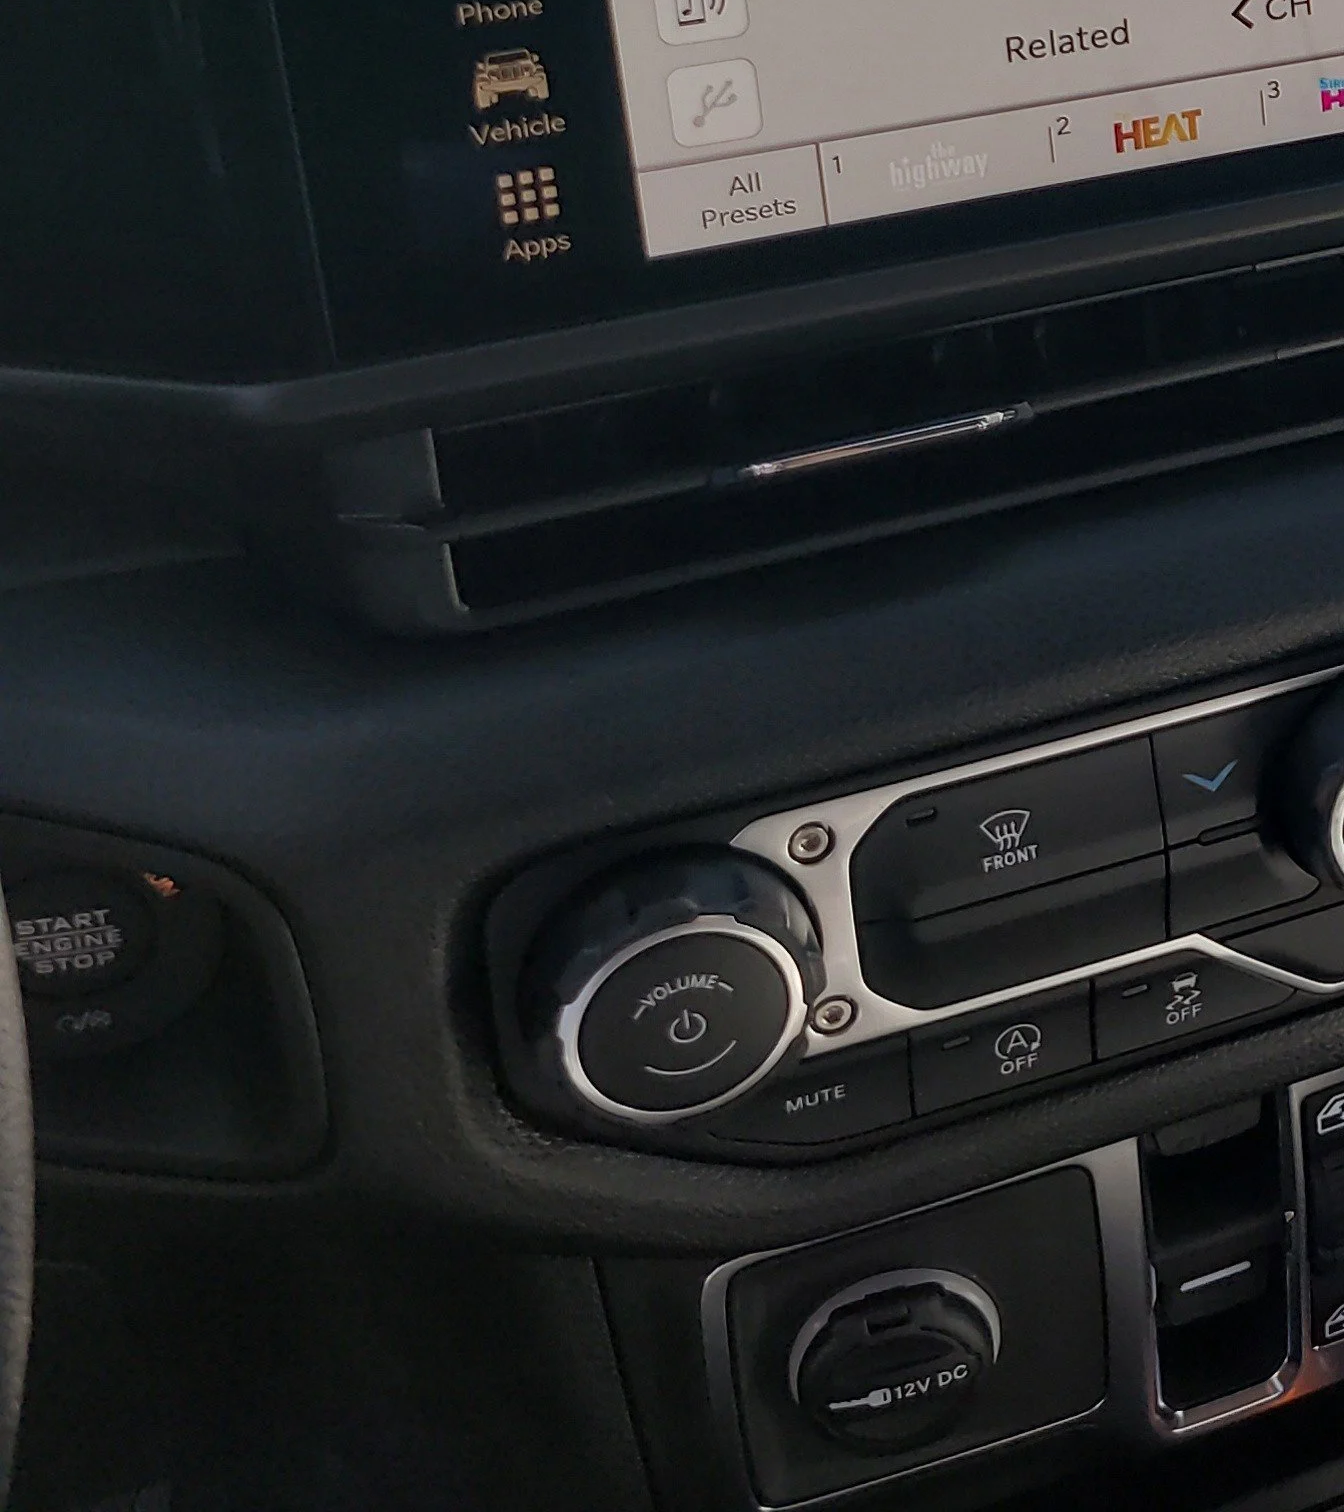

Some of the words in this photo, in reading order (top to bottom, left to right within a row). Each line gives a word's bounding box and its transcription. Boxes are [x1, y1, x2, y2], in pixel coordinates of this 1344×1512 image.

[1005, 19, 1131, 63] Related
[1267, 81, 1280, 99] 3
[469, 114, 567, 146] Vehicle
[1056, 117, 1071, 136] 2
[1113, 108, 1203, 154] HEAT
[833, 156, 843, 174] 1
[889, 152, 990, 190] highway
[729, 172, 763, 196] All
[702, 197, 798, 230] Presets
[505, 233, 572, 264] Apps
[983, 844, 1038, 872] FRONT
[15, 909, 111, 936] START
[14, 928, 124, 958] ENGINE
[35, 951, 116, 974] STOP
[639, 973, 719, 1008] VOLUME
[1166, 1003, 1203, 1025] OFF
[1000, 1053, 1039, 1075] OFF
[786, 1084, 846, 1114] MUTE
[894, 1377, 931, 1399] 12V
[937, 1364, 968, 1387] DC
